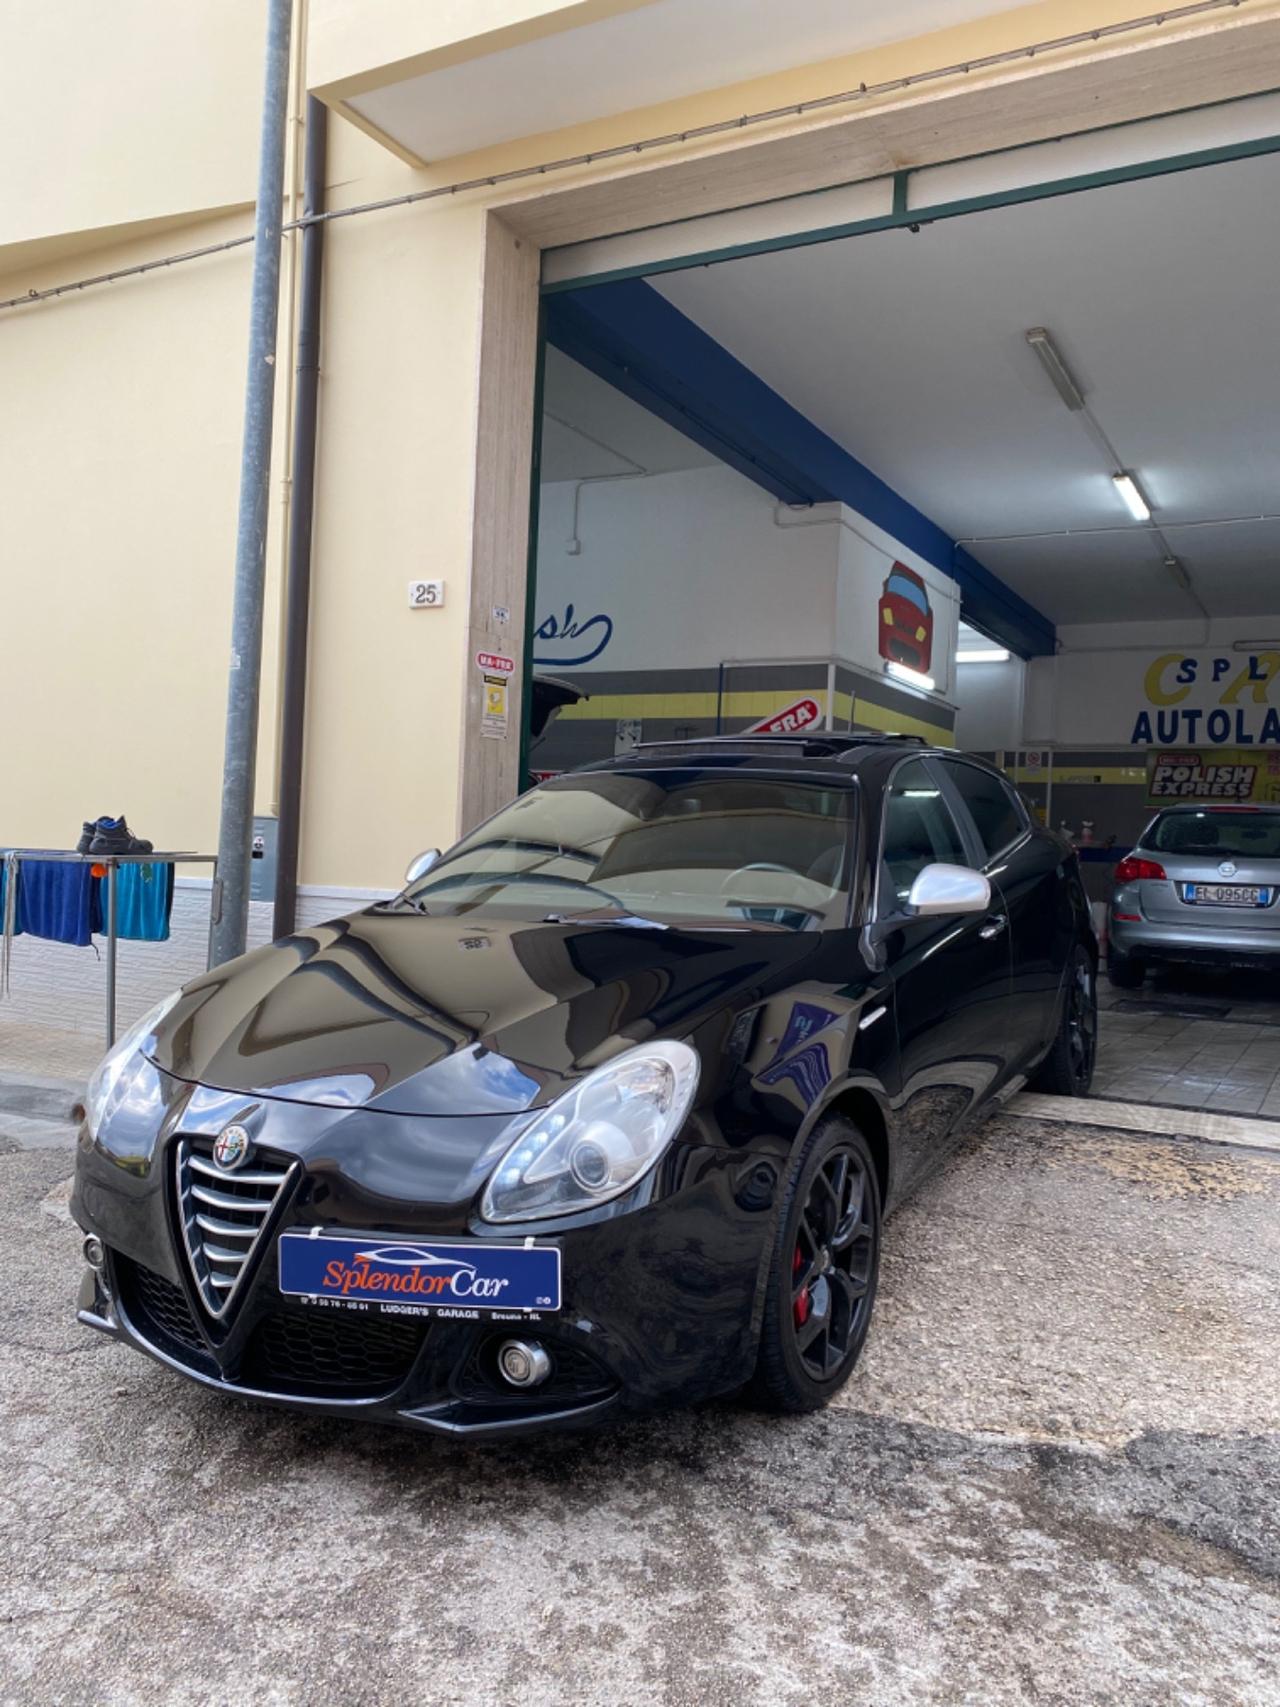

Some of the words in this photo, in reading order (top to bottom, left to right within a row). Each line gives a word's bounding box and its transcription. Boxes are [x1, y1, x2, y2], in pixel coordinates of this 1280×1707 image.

[415, 584, 437, 604] 25
[1130, 707, 1280, 744] AUTOLA
[1154, 766, 1255, 783] POLISH
[1151, 781, 1250, 797] EXPRESS
[322, 1260, 509, 1298] SplendorCar
[380, 1303, 429, 1317] LUDGER'S
[436, 1308, 480, 1320] GARAGE
